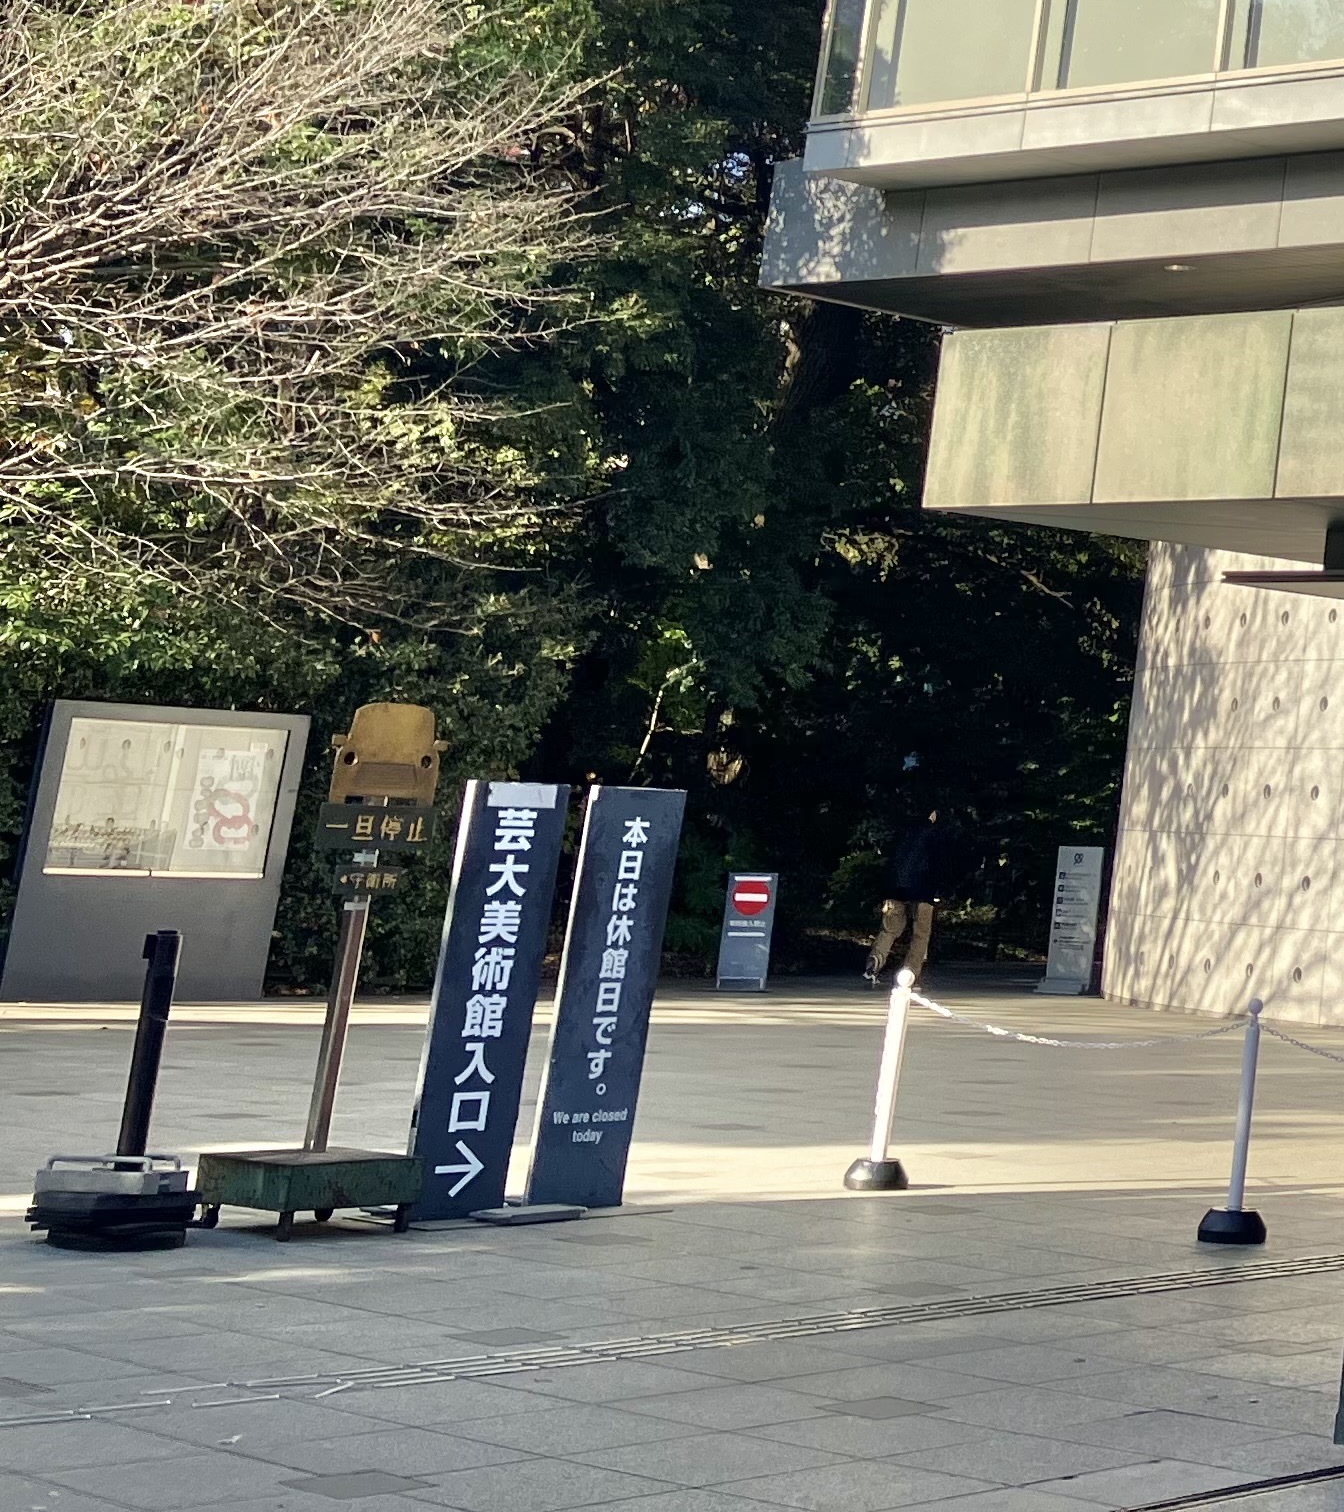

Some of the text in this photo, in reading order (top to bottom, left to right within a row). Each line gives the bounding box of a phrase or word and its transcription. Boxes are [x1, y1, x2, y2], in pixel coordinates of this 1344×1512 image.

[325, 814, 428, 841] 一旦停止
[586, 816, 650, 1096] 本日は休館日です。
[448, 808, 537, 1133] 芸大美術館入口
[553, 1108, 628, 1125] We are closed
[572, 1129, 603, 1144] today
